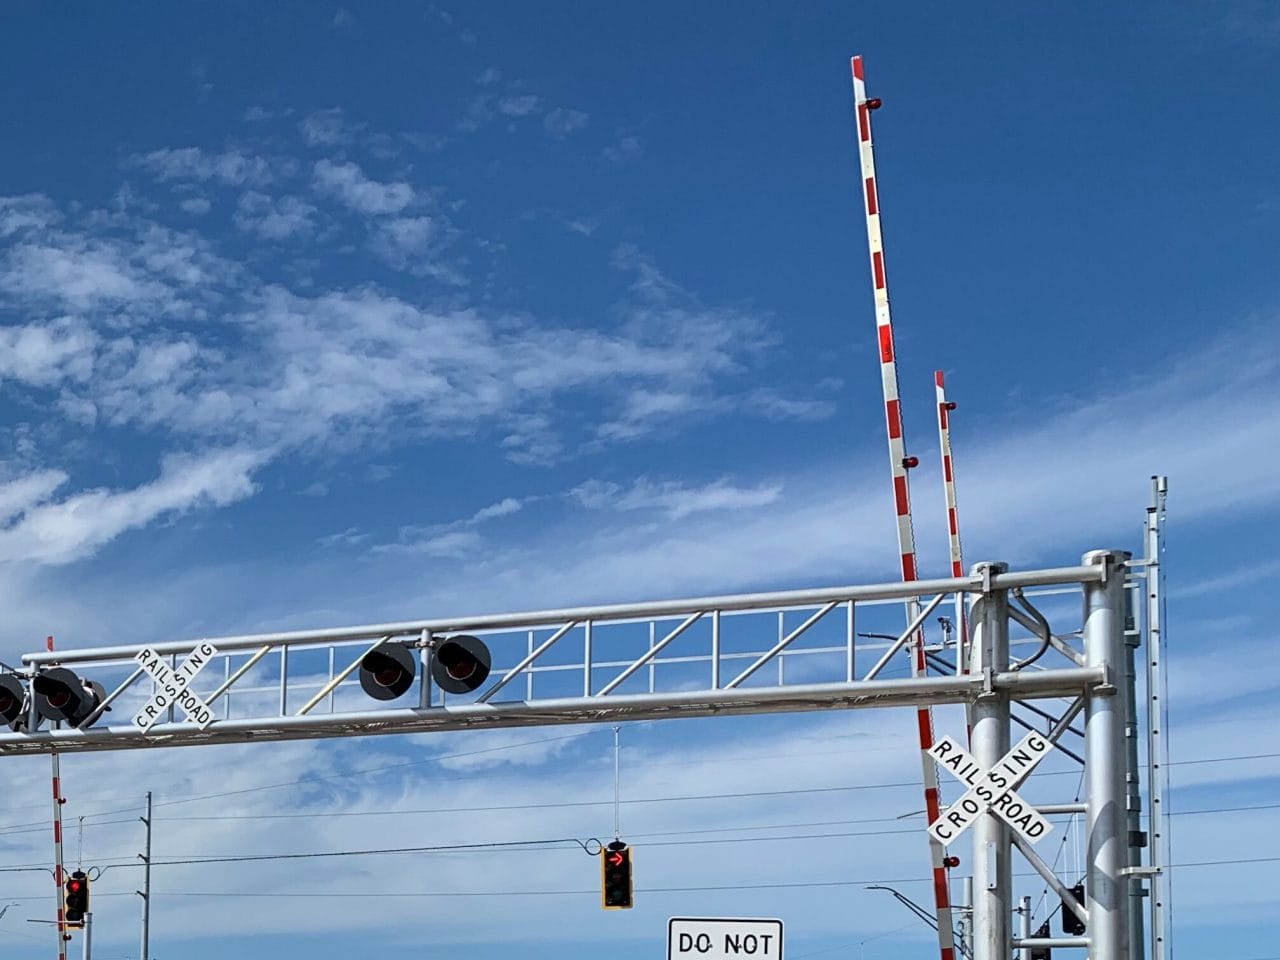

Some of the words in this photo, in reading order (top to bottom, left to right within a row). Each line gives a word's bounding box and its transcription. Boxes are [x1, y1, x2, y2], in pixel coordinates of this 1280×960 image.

[137, 645, 212, 727] CROSSING
[936, 737, 1045, 839] CROSSING
[680, 933, 710, 953] DO
[725, 934, 773, 954] NOT
